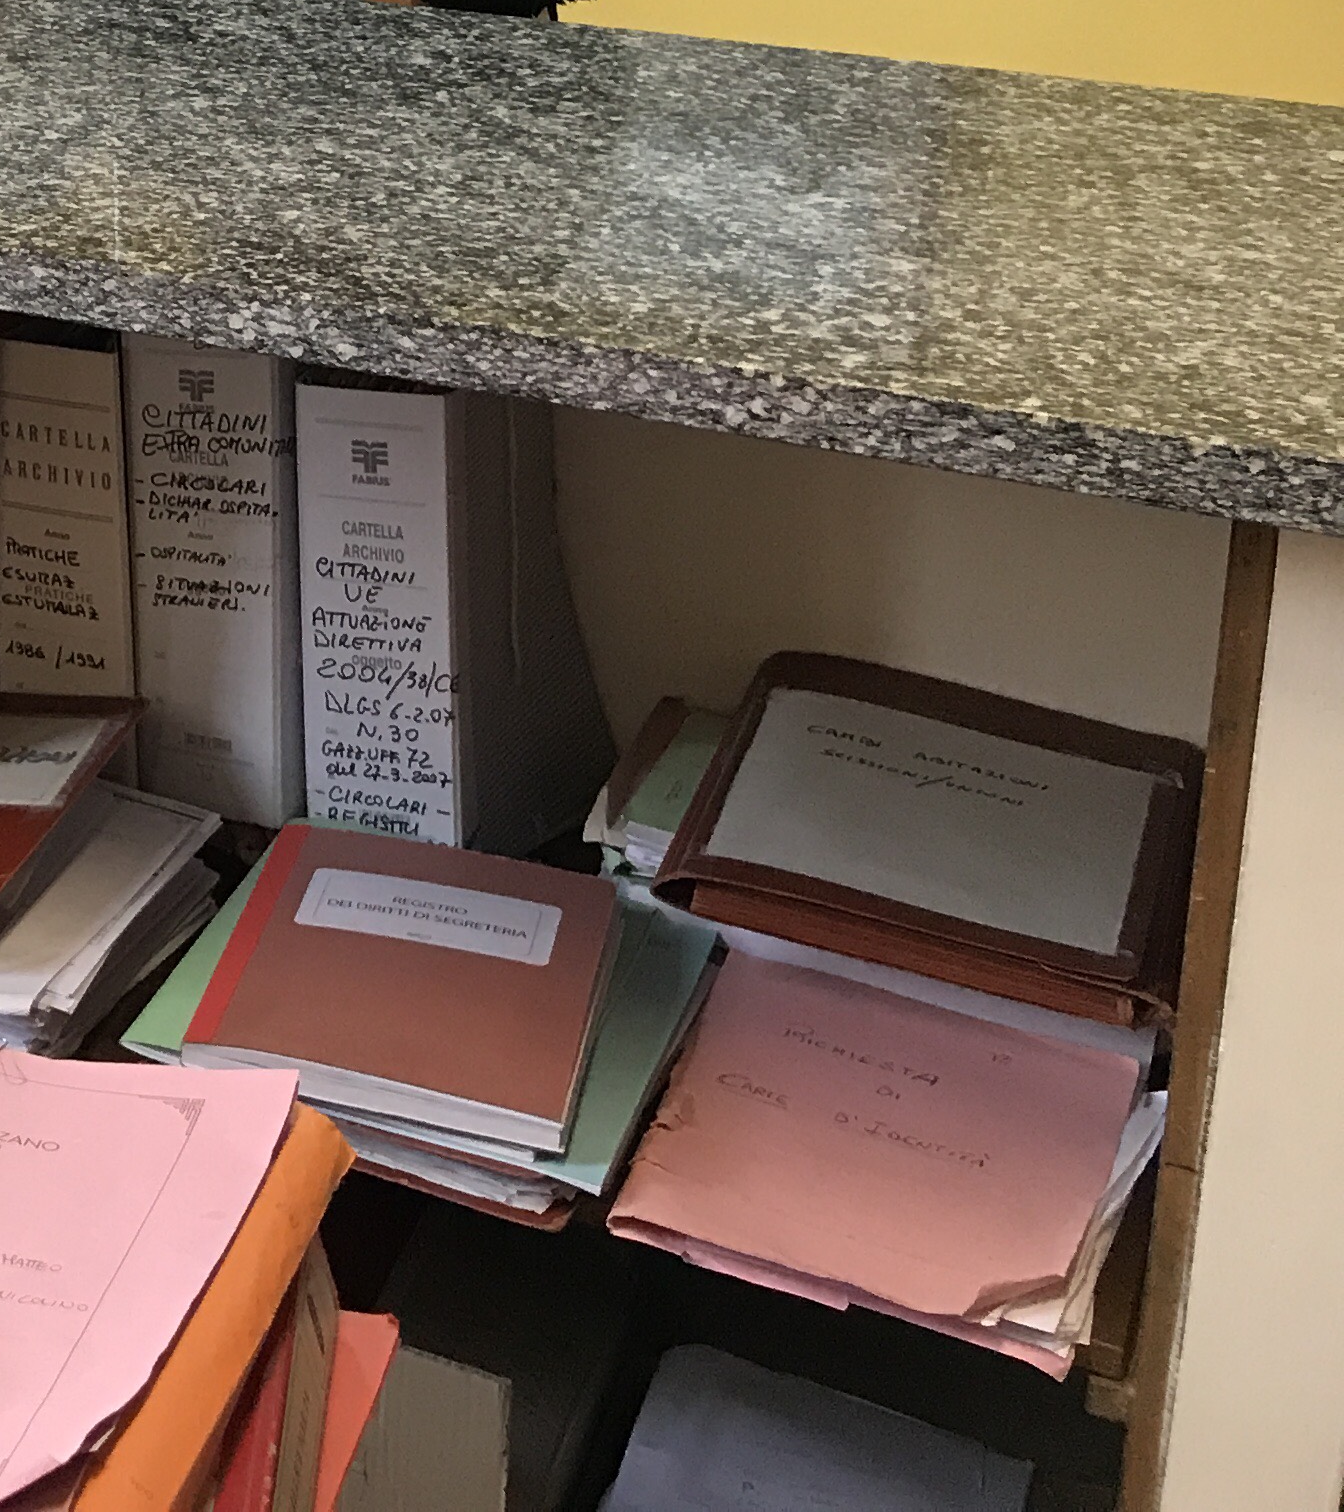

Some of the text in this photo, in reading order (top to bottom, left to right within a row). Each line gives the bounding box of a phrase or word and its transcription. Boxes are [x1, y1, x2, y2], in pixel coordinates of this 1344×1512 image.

[142, 403, 267, 435] CITTADINI
[0, 420, 112, 453] CARTELLA
[3, 458, 112, 491] ARCHIVIO
[342, 520, 404, 540] CARTELLA
[5, 536, 82, 568] PRATICHE
[342, 543, 405, 564] ARCHIVIO
[316, 556, 416, 585] CITTADINI
[344, 584, 383, 604] UE
[312, 606, 432, 633] ATTUAZIONE
[313, 630, 422, 654] DIRETTIVA
[324, 690, 382, 716] DLGS
[390, 725, 420, 742] 30
[406, 746, 434, 769] 72
[328, 785, 427, 816] CIRCOLARI
[326, 897, 354, 910] DEI
[412, 909, 430, 921] DI
[431, 911, 528, 940] SEGRETERIA
[392, 895, 468, 916] REGISTRO
